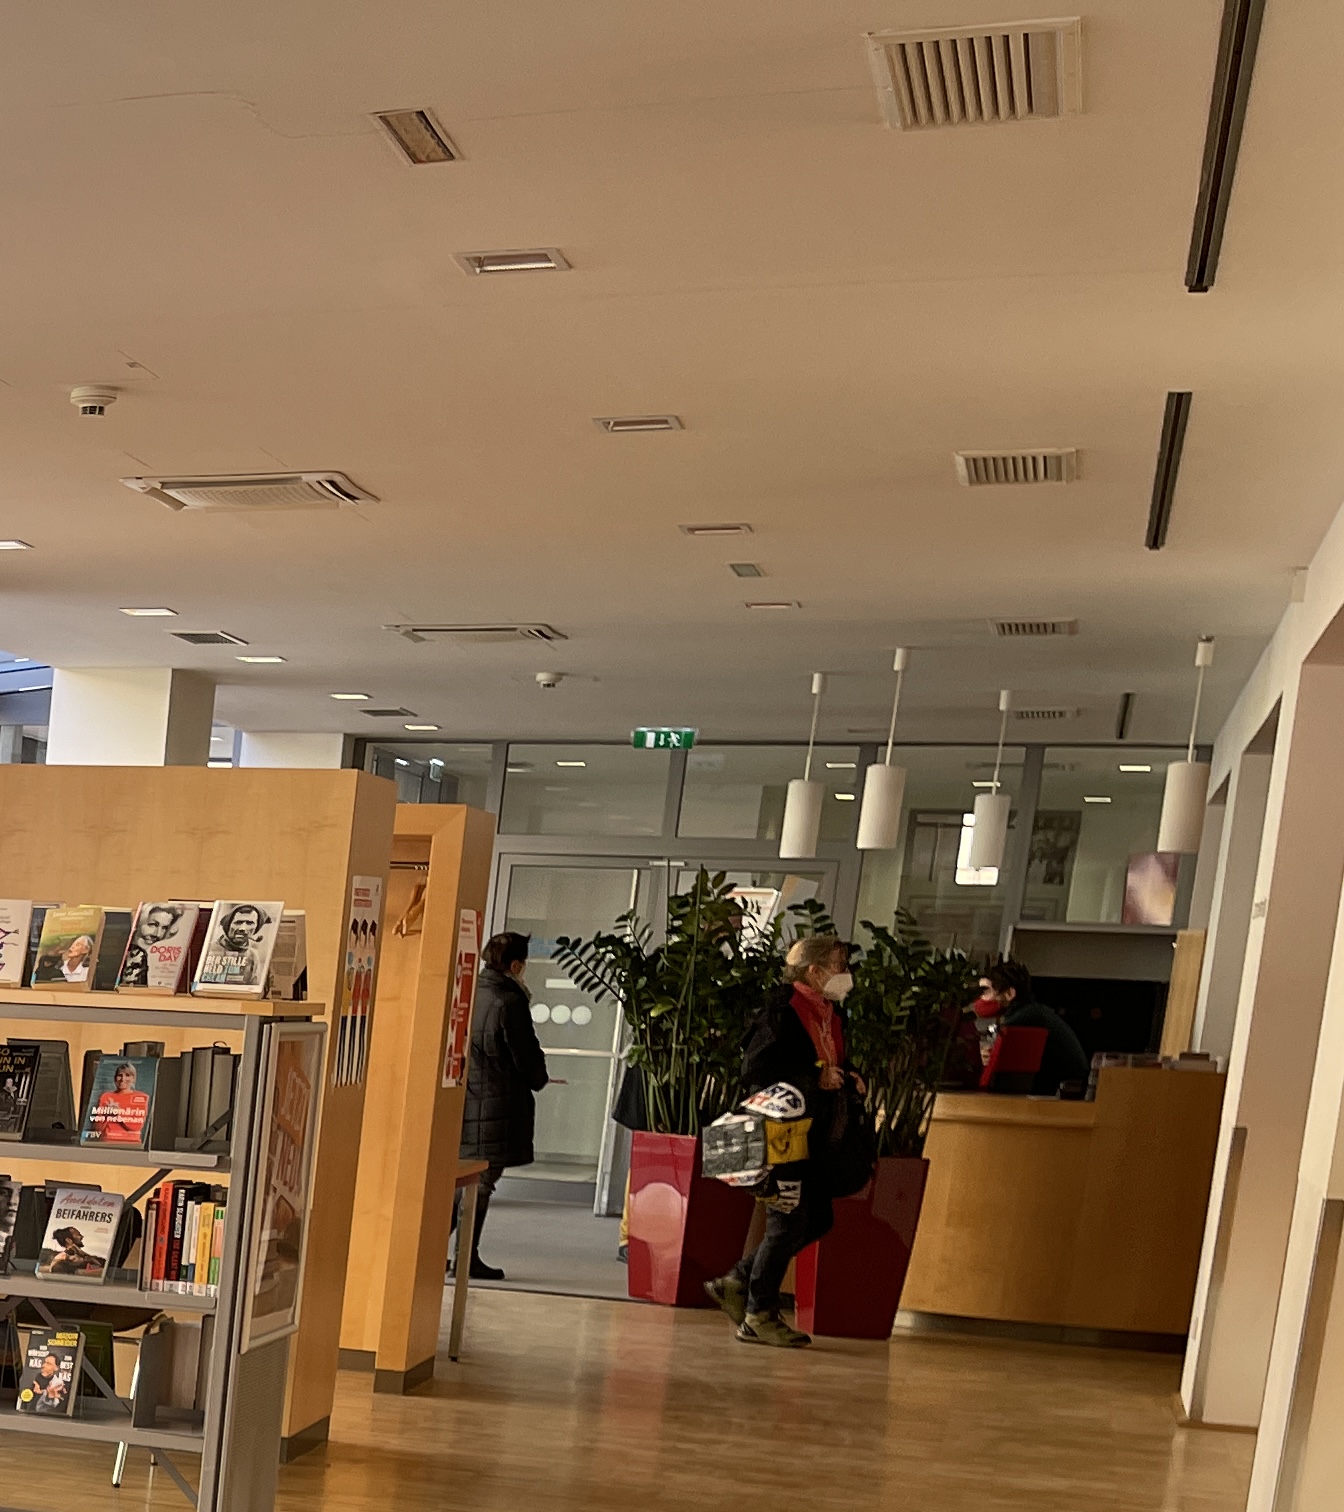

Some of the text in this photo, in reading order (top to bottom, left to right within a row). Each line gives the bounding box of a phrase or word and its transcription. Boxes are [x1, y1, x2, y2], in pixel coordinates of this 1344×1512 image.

[150, 946, 181, 954] DORIS
[159, 950, 180, 962] DAY
[222, 956, 248, 966] STILLE
[92, 1106, 145, 1116] Millionärin
[55, 1208, 113, 1223] BEIFAHRERS
